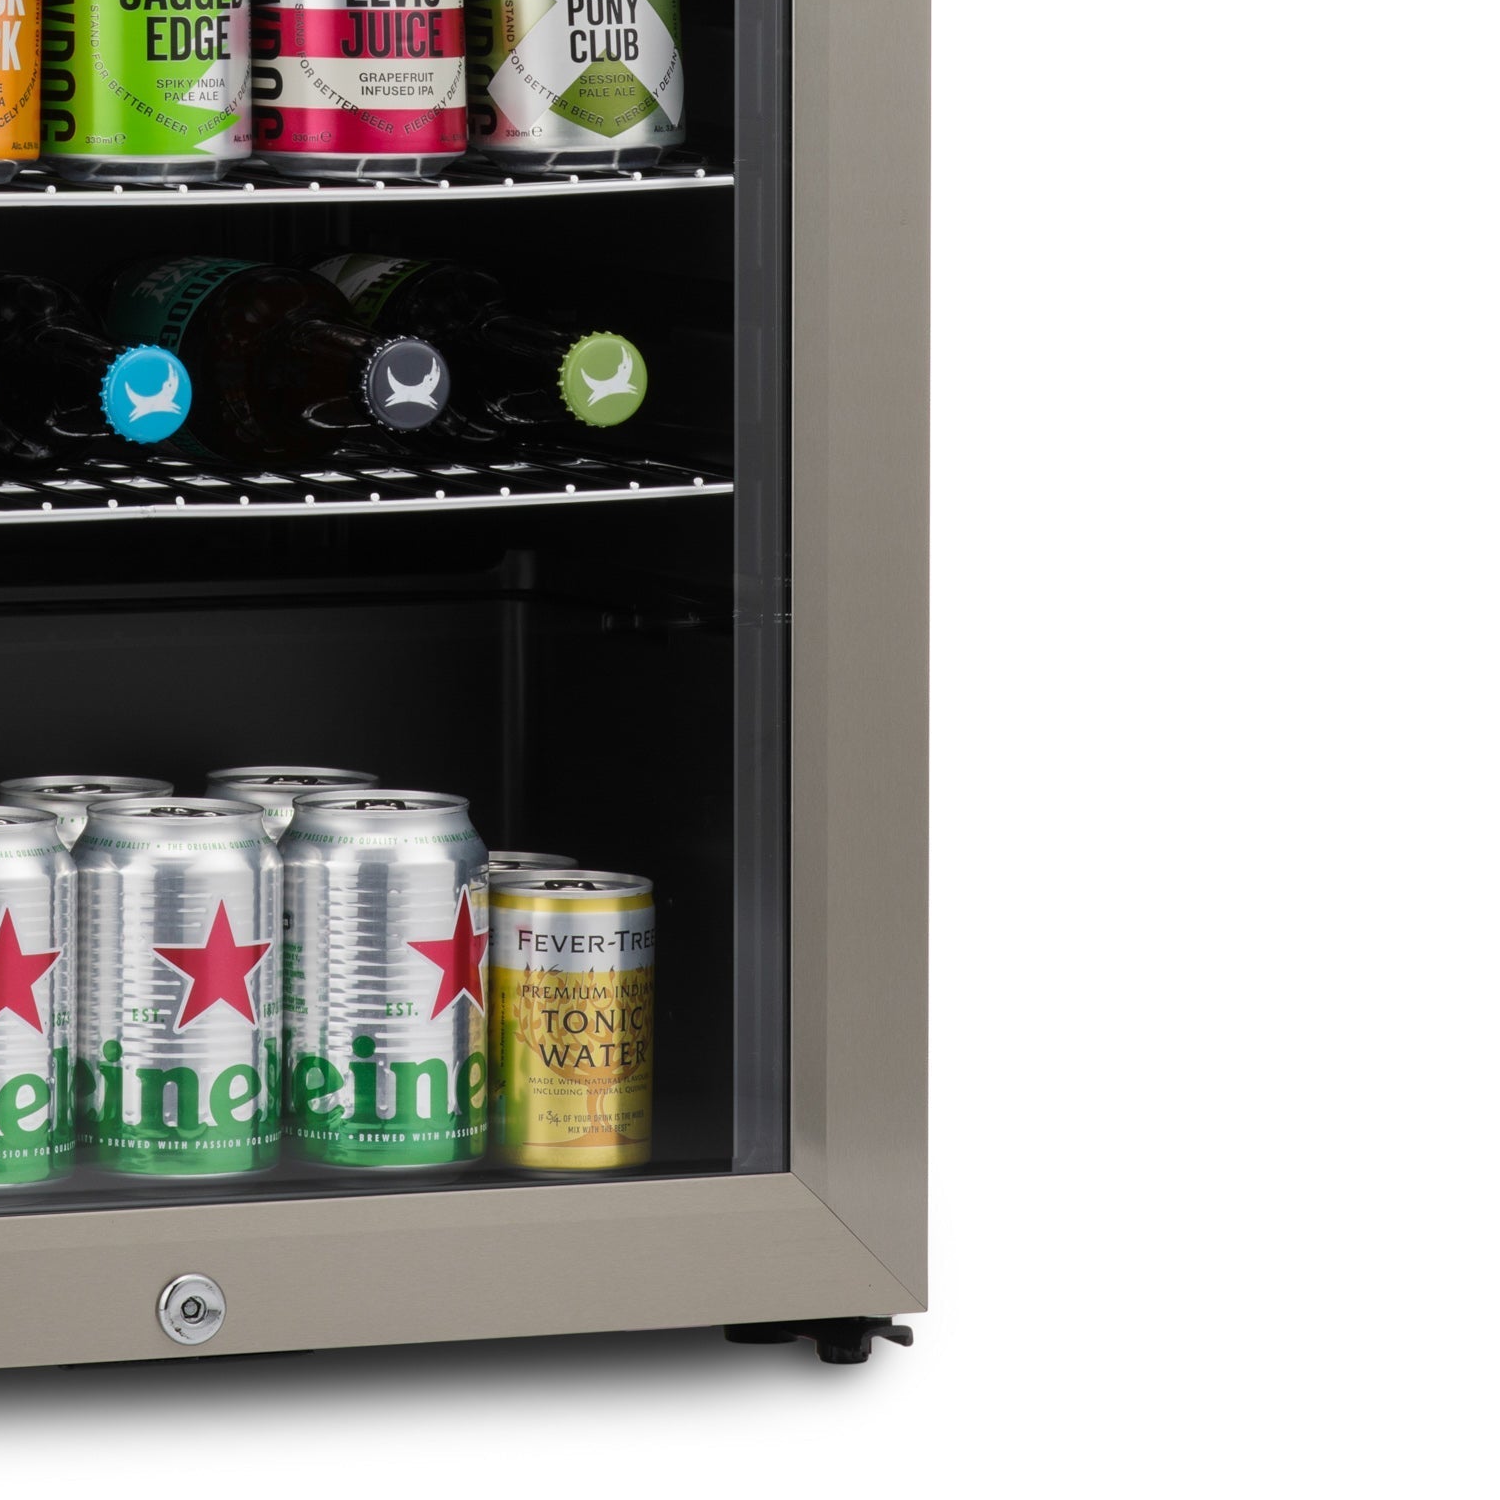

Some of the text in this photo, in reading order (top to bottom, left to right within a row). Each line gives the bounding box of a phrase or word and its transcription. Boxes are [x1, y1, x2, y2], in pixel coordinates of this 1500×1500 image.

[505, 0, 515, 43] STAND
[146, 15, 231, 61] EDGE
[340, 11, 444, 58] JUICE
[570, 28, 639, 64] CLUB
[508, 47, 525, 75] FOR
[156, 78, 226, 89] SPIKY INDIA
[358, 72, 434, 83] GRAPEFRUIT
[579, 74, 634, 85] SESSION
[164, 91, 220, 102] PALE ALE
[361, 85, 434, 96] INFUSED IPA
[523, 74, 568, 110] BETTER
[579, 86, 636, 98] PALE ALE
[570, 105, 605, 127] BEER
[614, 90, 659, 127] FIERCELY
[522, 986, 607, 1000] PREMIUM
[132, 1008, 165, 1023] EST.
[385, 1002, 419, 1017] EST.
[541, 1007, 644, 1035] TONIC
[539, 1041, 647, 1068] WATER
[528, 1077, 554, 1085] MADE
[558, 1077, 580, 1085] WITH
[563, 1114, 571, 1122] OF
[574, 1114, 591, 1122] YOUR
[359, 1133, 405, 1143] BREWED
[412, 1132, 440, 1141] WITH
[445, 1126, 478, 1139] PASSION
[108, 1136, 262, 1150] BREWED WITH PASSION FOR
